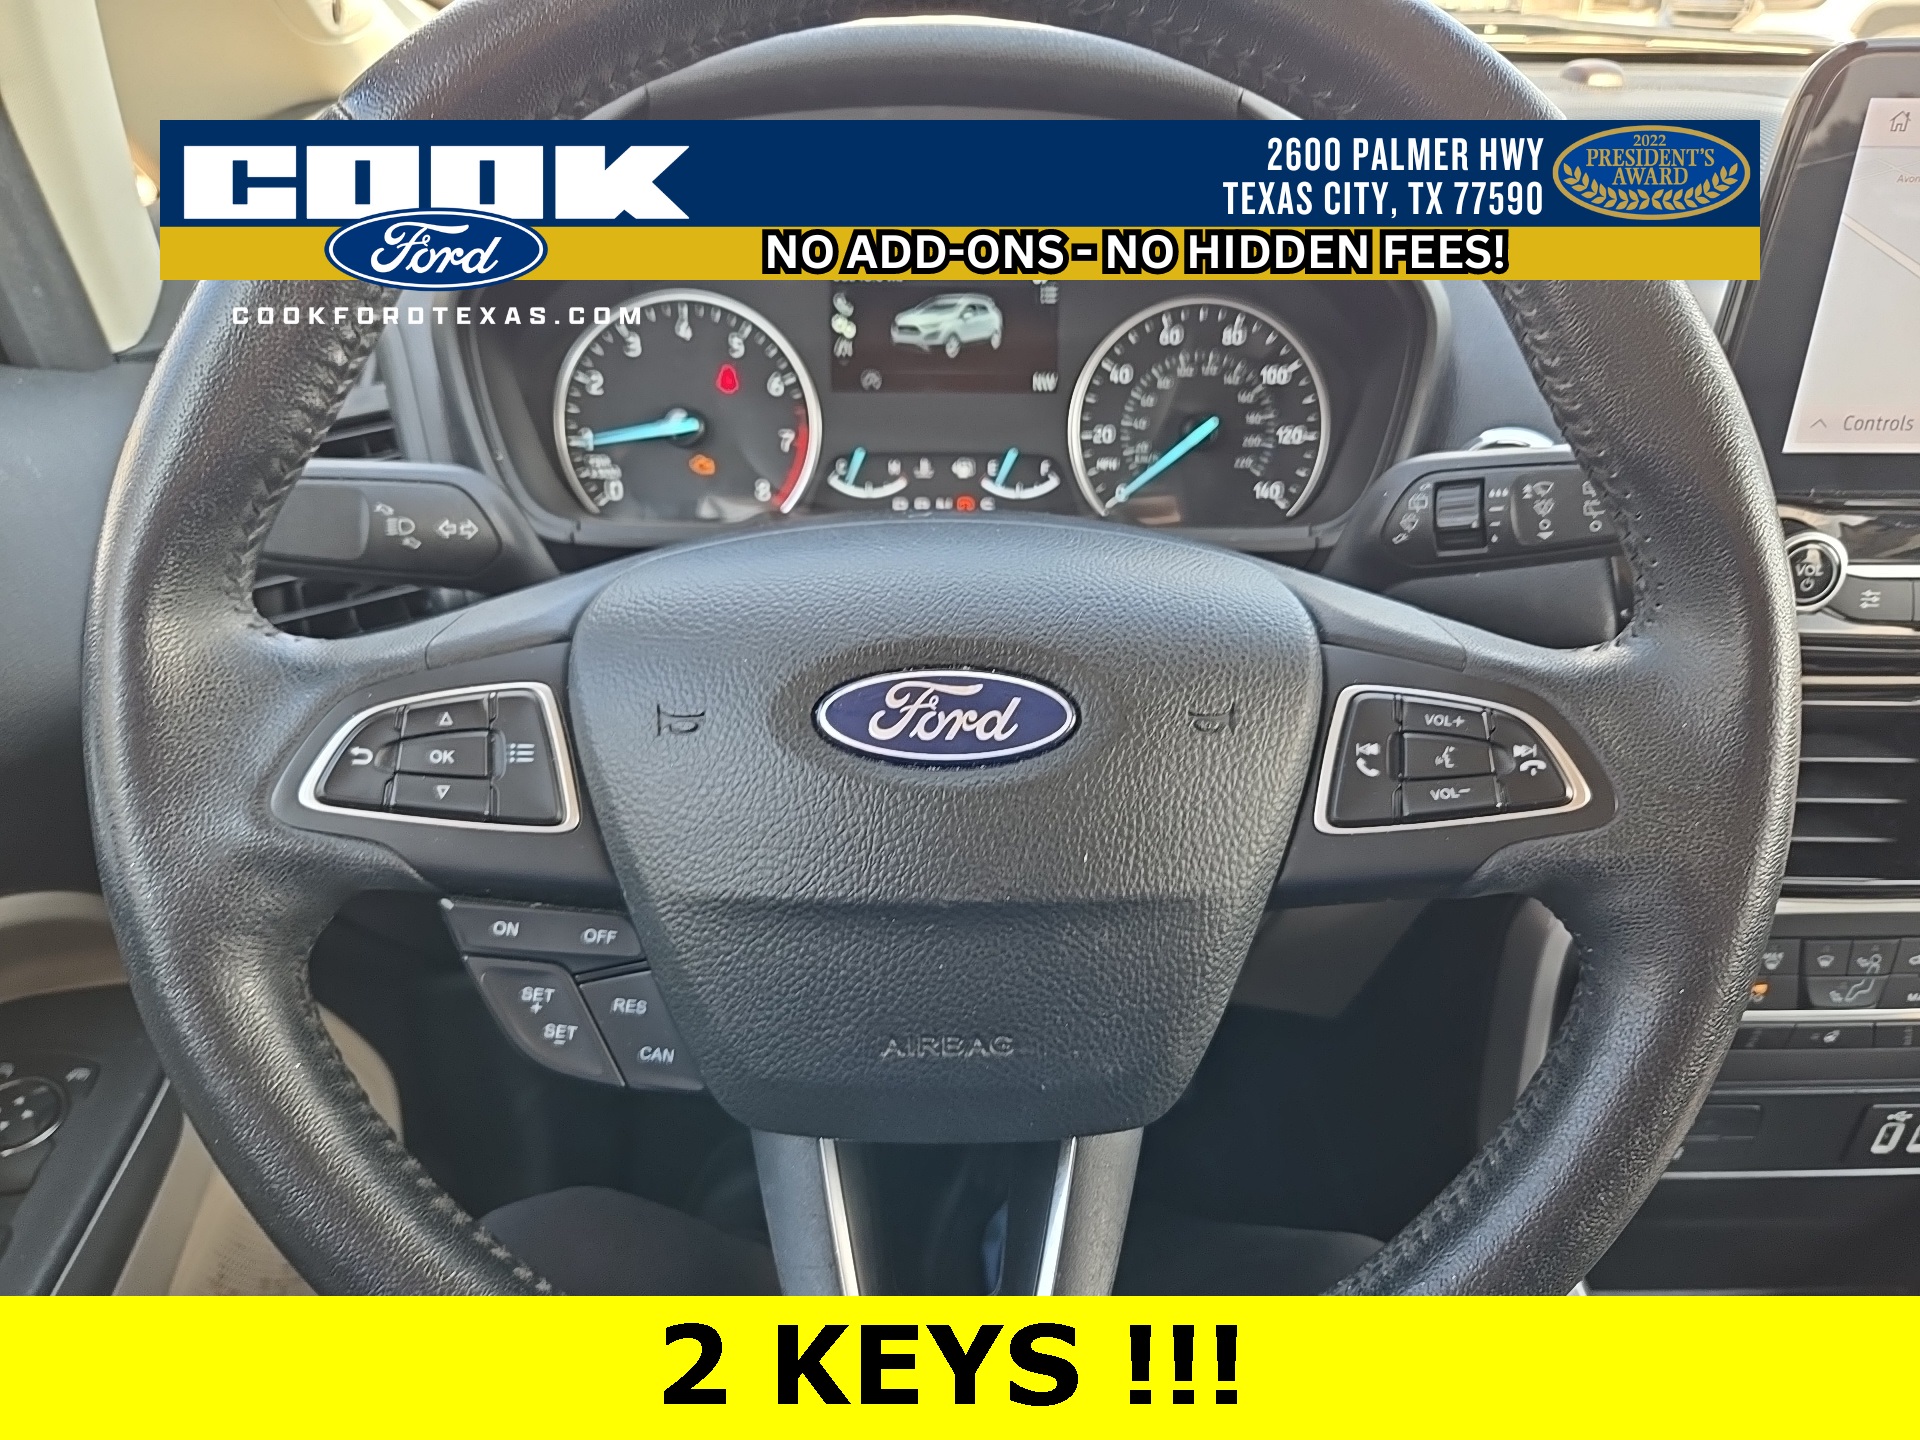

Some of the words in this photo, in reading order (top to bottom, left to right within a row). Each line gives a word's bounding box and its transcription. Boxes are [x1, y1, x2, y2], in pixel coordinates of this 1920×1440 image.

[585, 370, 604, 395] 2
[1109, 363, 1134, 385] 40
[1260, 364, 1292, 386] 100
[766, 371, 785, 397] 6
[1843, 414, 1914, 432] Controls
[778, 428, 795, 453] 7
[1092, 424, 1116, 445] 20
[1276, 425, 1308, 445] 120
[604, 479, 624, 501] 0
[754, 478, 772, 502] 8
[1253, 481, 1285, 500] 140
[1795, 565, 1824, 577] VOL
[868, 680, 1022, 742] Ford
[1424, 713, 1465, 728] VOL+
[429, 749, 455, 765] OK
[1430, 787, 1471, 801] VOL-
[491, 920, 520, 937] ON
[581, 928, 618, 945] OFF
[520, 985, 556, 1003] SET
[611, 997, 648, 1015] RES
[542, 1022, 579, 1041] SET
[637, 1045, 675, 1064] CAN
[879, 1035, 1015, 1060] AIRBAG
